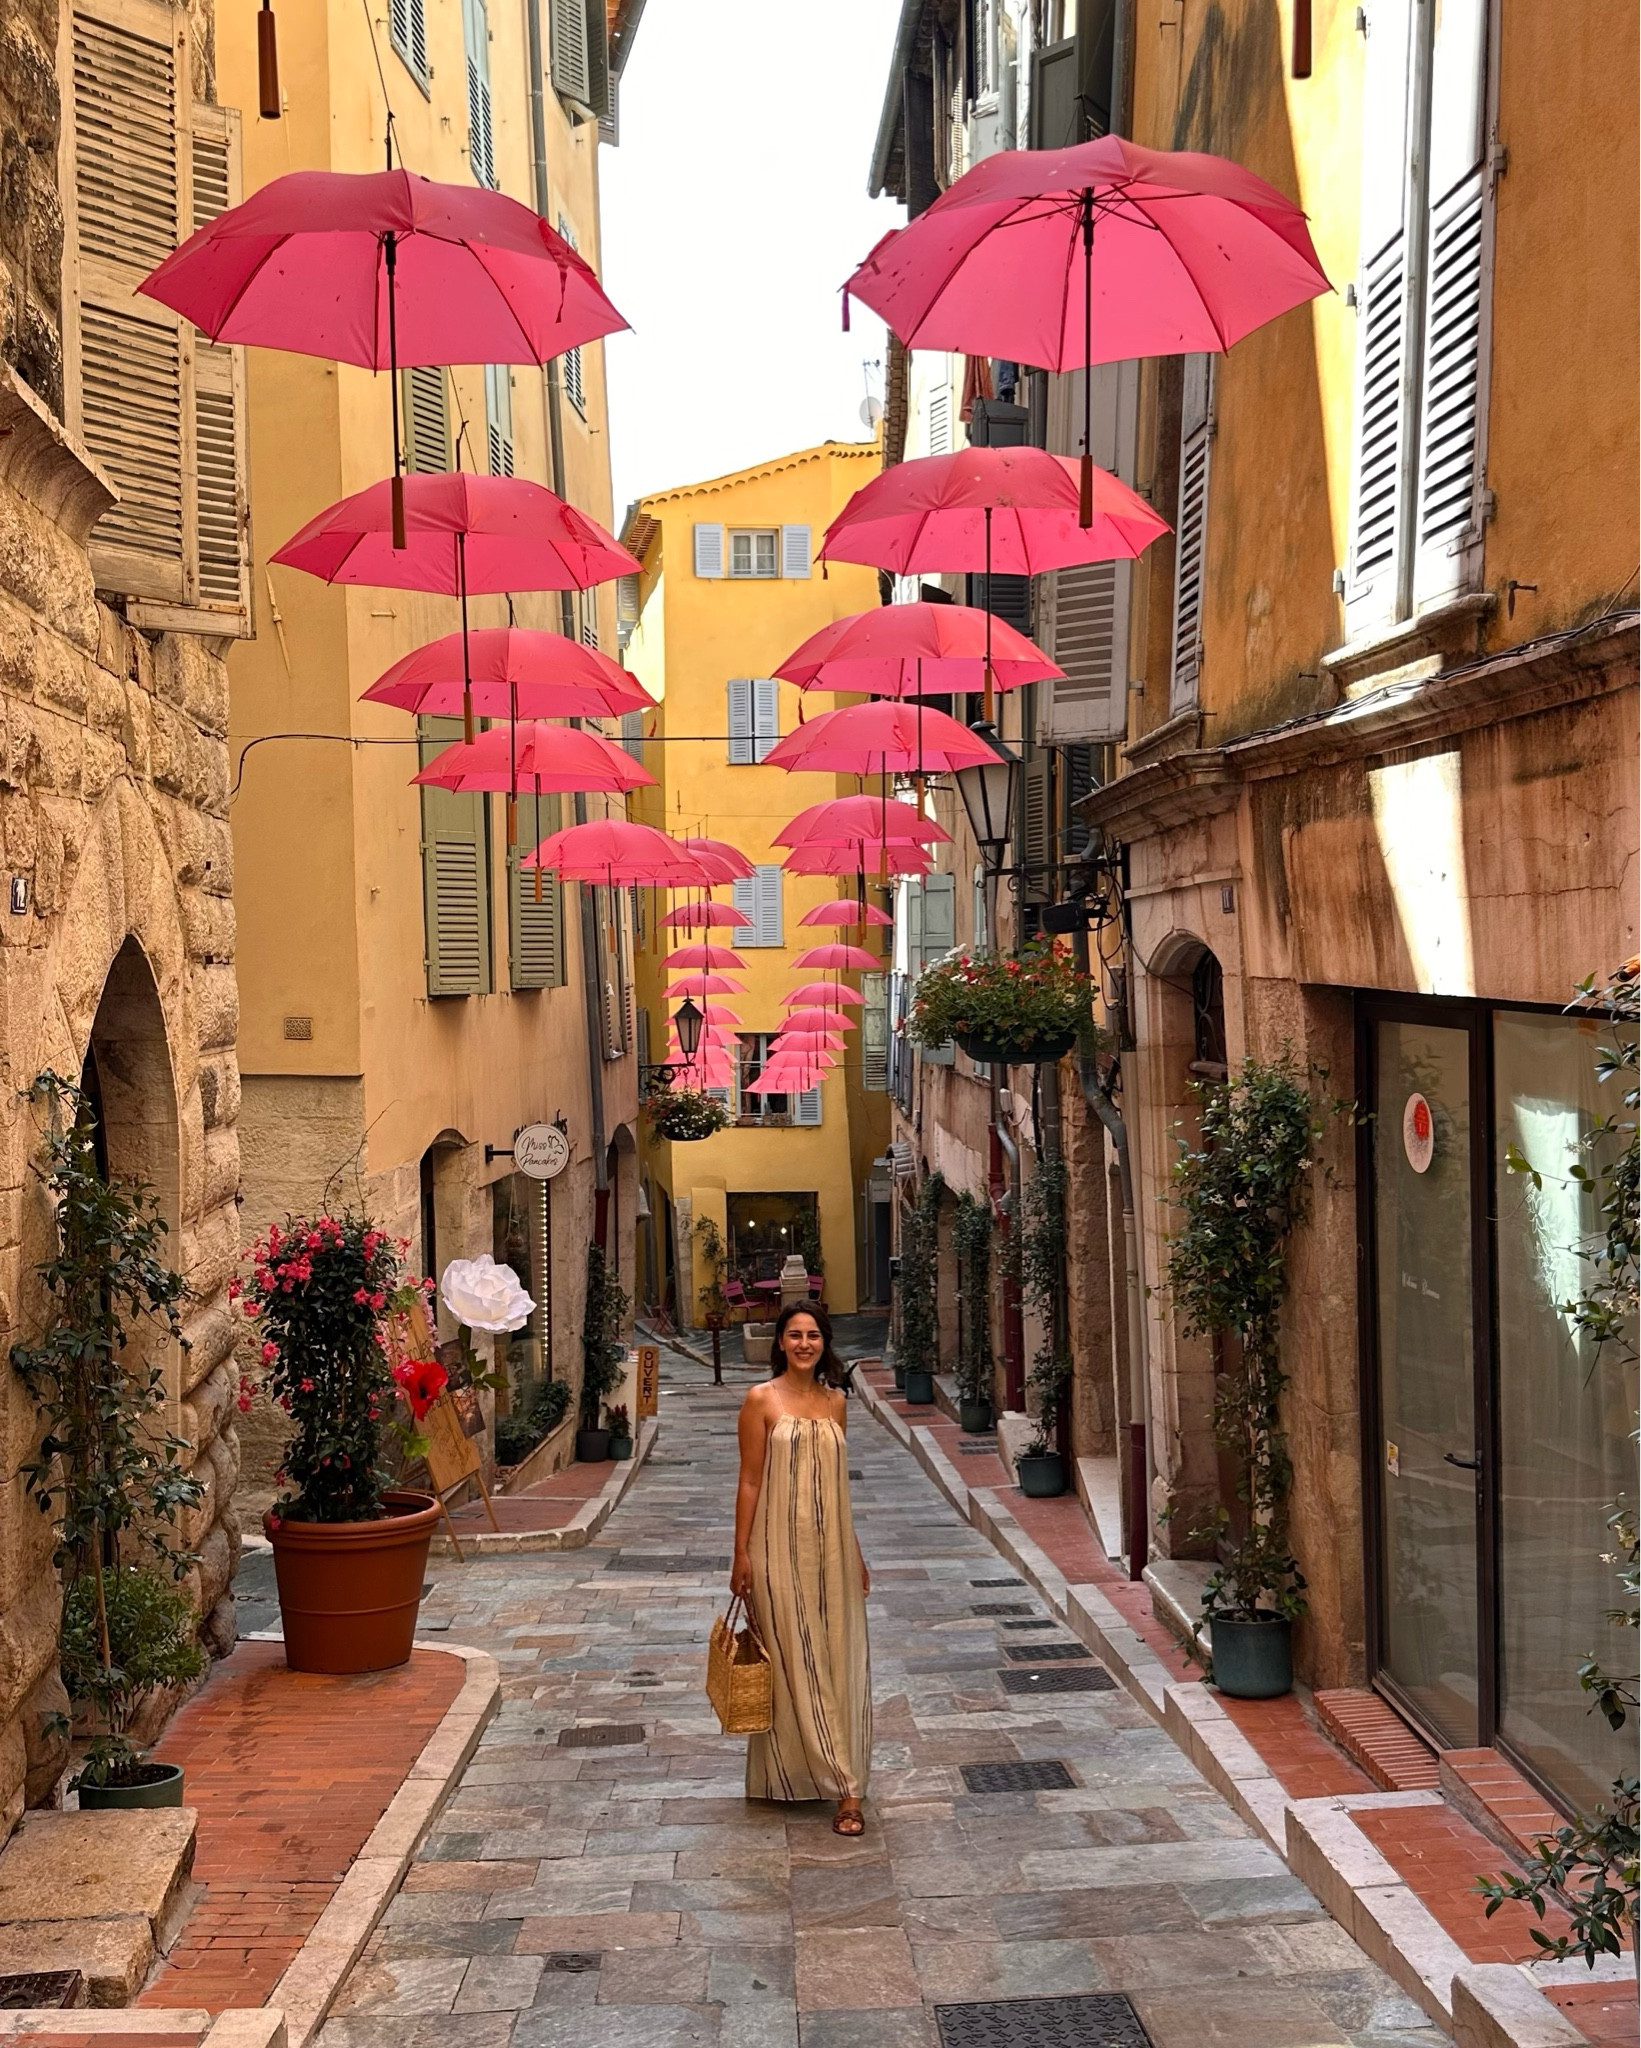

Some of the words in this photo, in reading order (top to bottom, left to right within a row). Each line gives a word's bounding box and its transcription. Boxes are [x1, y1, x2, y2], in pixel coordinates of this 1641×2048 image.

[521, 1135, 547, 1153] Miss
[520, 1153, 558, 1168] Pancakes
[643, 1351, 654, 1404] OUVERT
